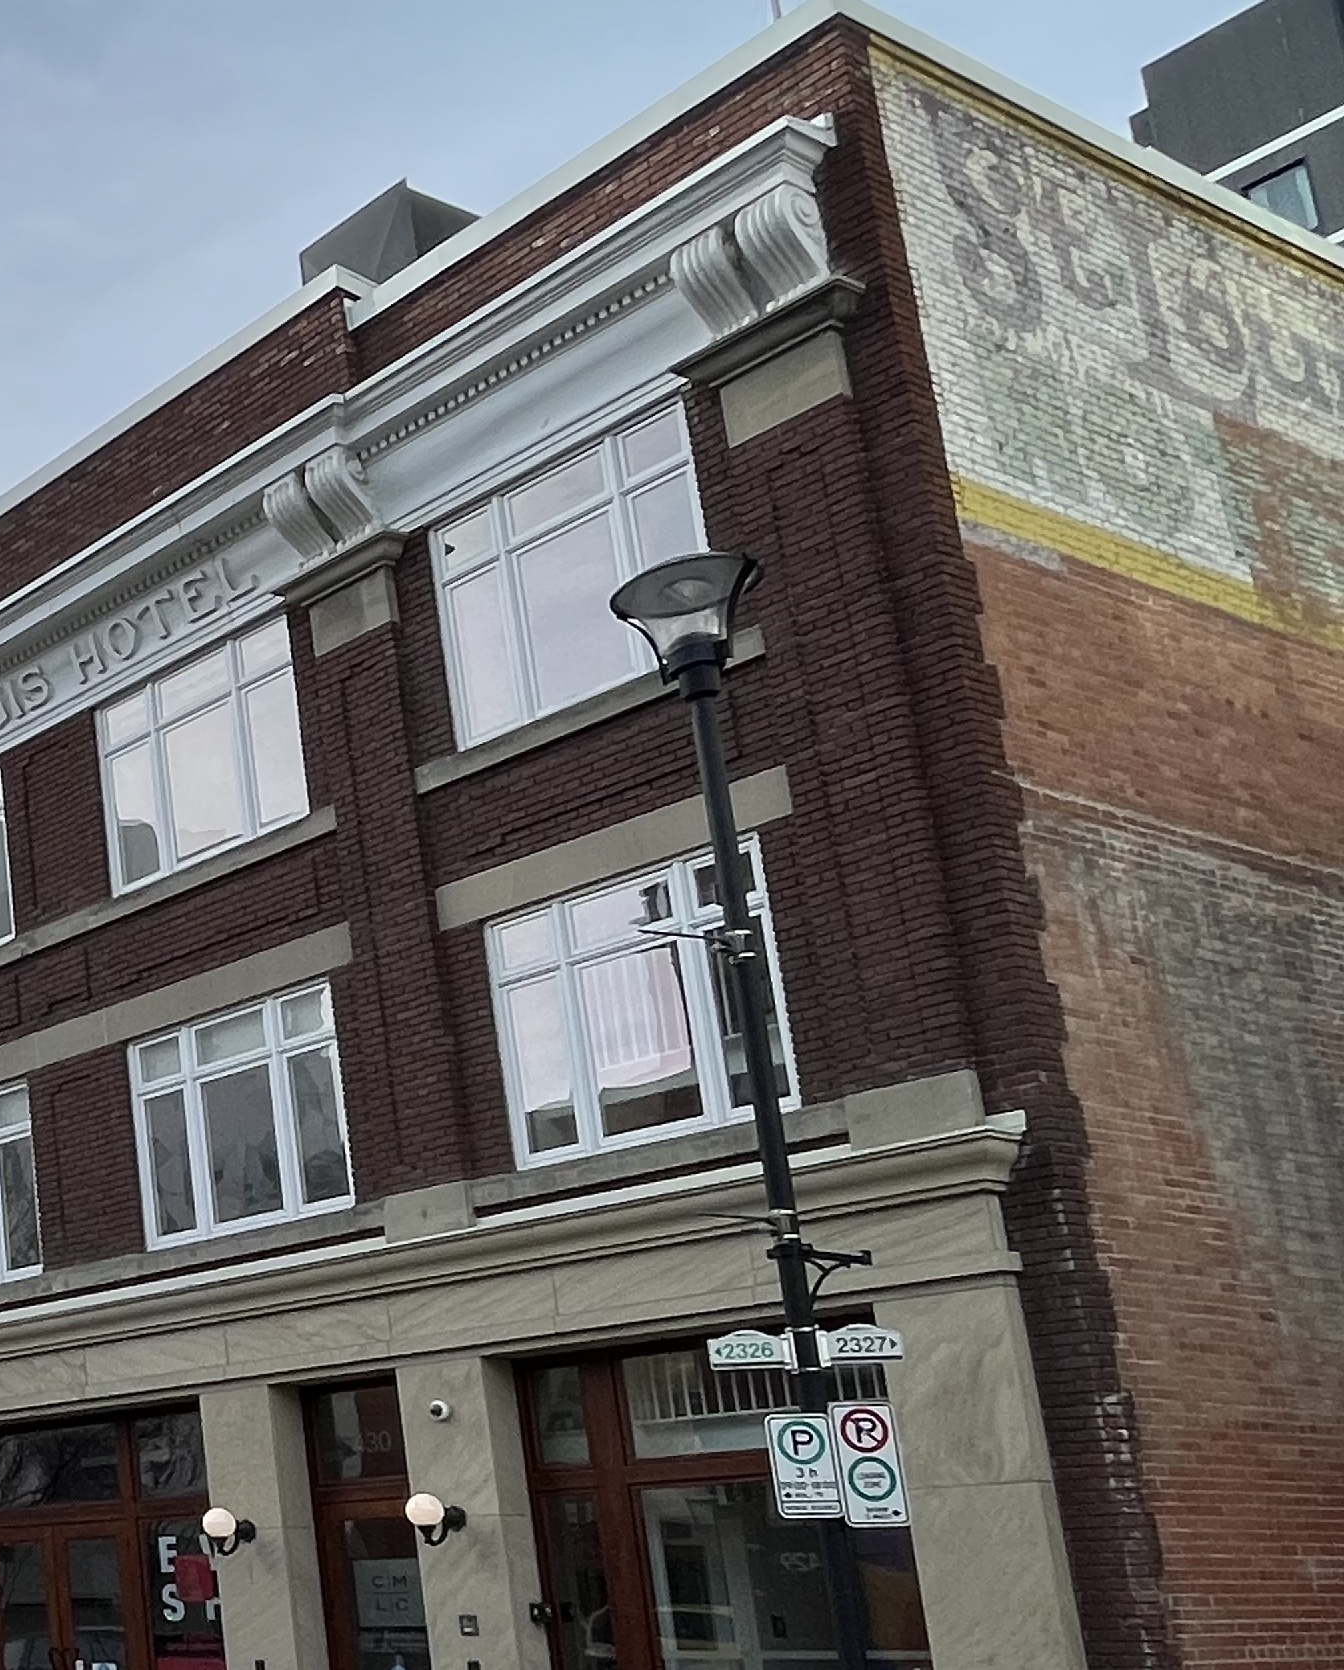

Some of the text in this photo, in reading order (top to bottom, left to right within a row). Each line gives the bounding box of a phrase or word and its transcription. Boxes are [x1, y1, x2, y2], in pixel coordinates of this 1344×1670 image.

[70, 556, 261, 685] HOTEL
[722, 1341, 775, 1360] 2326
[835, 1335, 888, 1354] 2327
[791, 1429, 814, 1456] P
